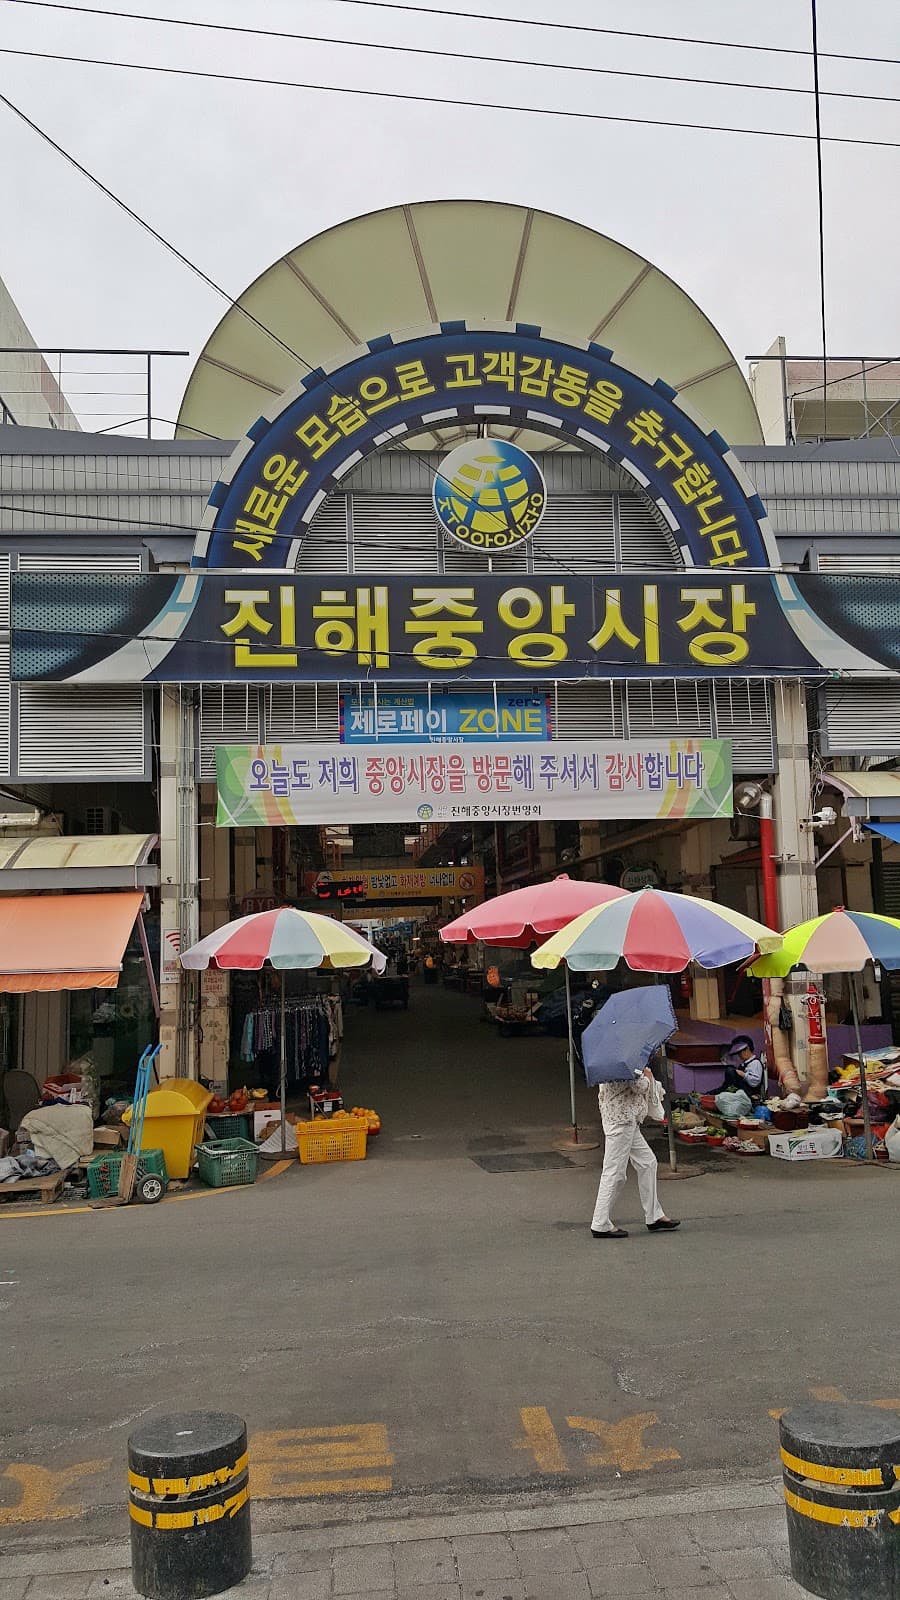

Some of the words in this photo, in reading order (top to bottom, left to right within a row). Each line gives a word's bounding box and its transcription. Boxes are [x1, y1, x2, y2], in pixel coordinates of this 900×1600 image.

[232, 453, 309, 562] 새로운
[296, 360, 436, 460] 모습으로
[445, 351, 624, 425] 고객감동을
[625, 409, 749, 568] 추구합니다
[219, 584, 757, 669] 진해중앙시장
[350, 709, 447, 734] 제로페이
[459, 709, 542, 733] ZONE
[250, 757, 311, 797] 오늘도
[318, 756, 359, 793] 저희
[365, 754, 468, 796] 중앙시장을
[472, 753, 534, 792] 방문해
[539, 752, 600, 790] 주셔서
[605, 751, 704, 791] 감사합니다
